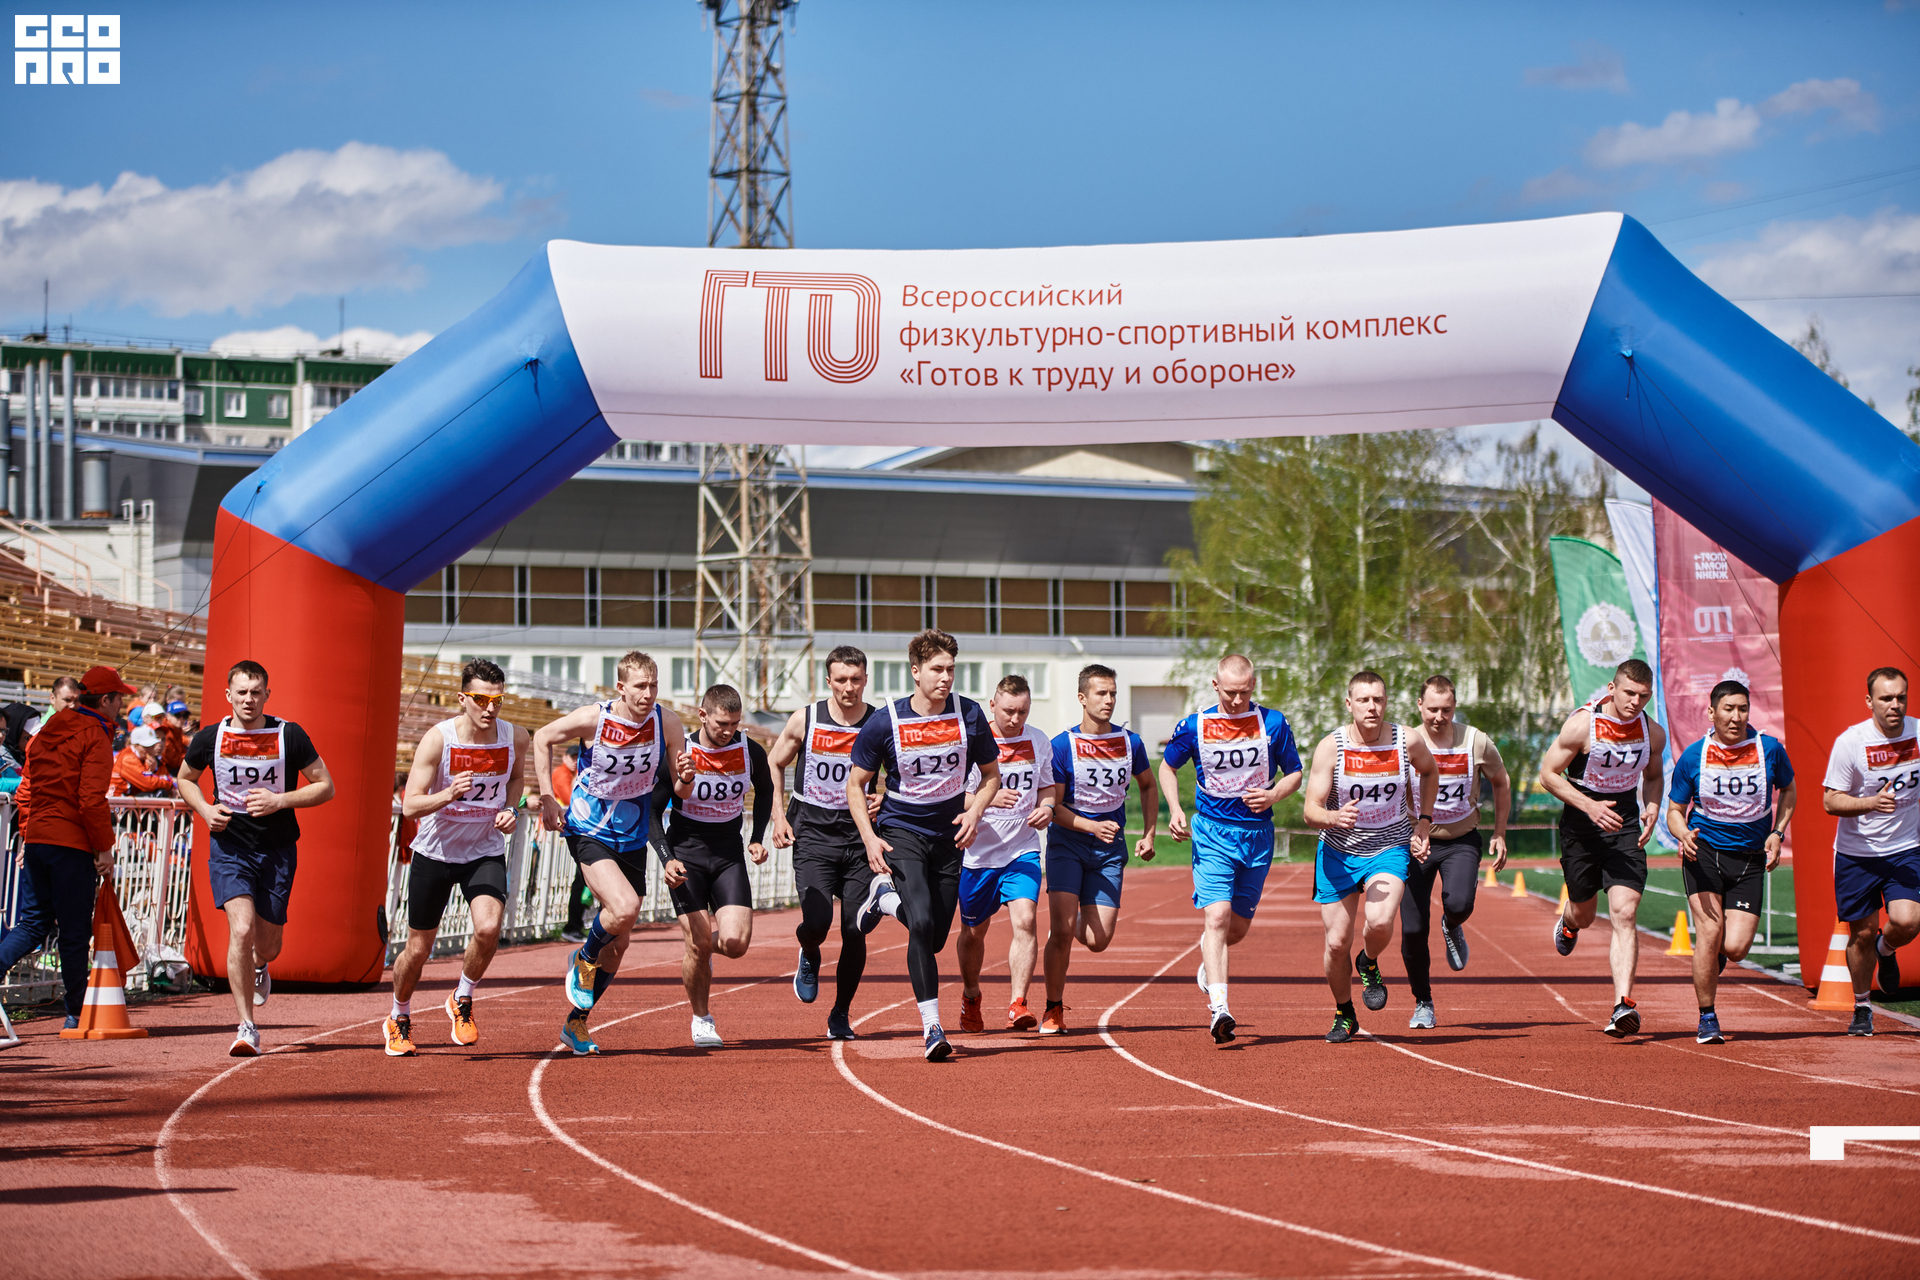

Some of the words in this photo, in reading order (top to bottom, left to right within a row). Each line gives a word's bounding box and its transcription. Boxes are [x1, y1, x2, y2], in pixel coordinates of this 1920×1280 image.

[902, 283, 1122, 313] Всероссийский
[700, 269, 881, 384] ГТО
[900, 315, 1294, 353] физкультурно-спортивный
[1306, 314, 1448, 340] комплекс
[900, 361, 998, 386] «Готов
[1009, 368, 1024, 386] к
[1032, 366, 1114, 391] труду
[1125, 366, 1141, 385] и
[1153, 358, 1296, 389] обороне»
[605, 726, 624, 742] ГТО
[816, 734, 833, 748] ГТО
[904, 729, 922, 743] ГТО
[1079, 742, 1097, 754] ГТО
[1870, 751, 1888, 763] ГТО
[454, 754, 472, 767] ГТО
[604, 752, 651, 775] 233
[911, 752, 960, 777] 129
[1213, 747, 1261, 770] 202
[1346, 756, 1364, 769] ГТО
[1601, 749, 1643, 770] 177
[228, 766, 278, 785] 194
[816, 762, 853, 782] 00
[1086, 767, 1127, 787] 338
[1876, 770, 1919, 793] 265
[697, 781, 744, 801] 089
[1350, 782, 1397, 803] 049
[1712, 775, 1759, 796] 105
